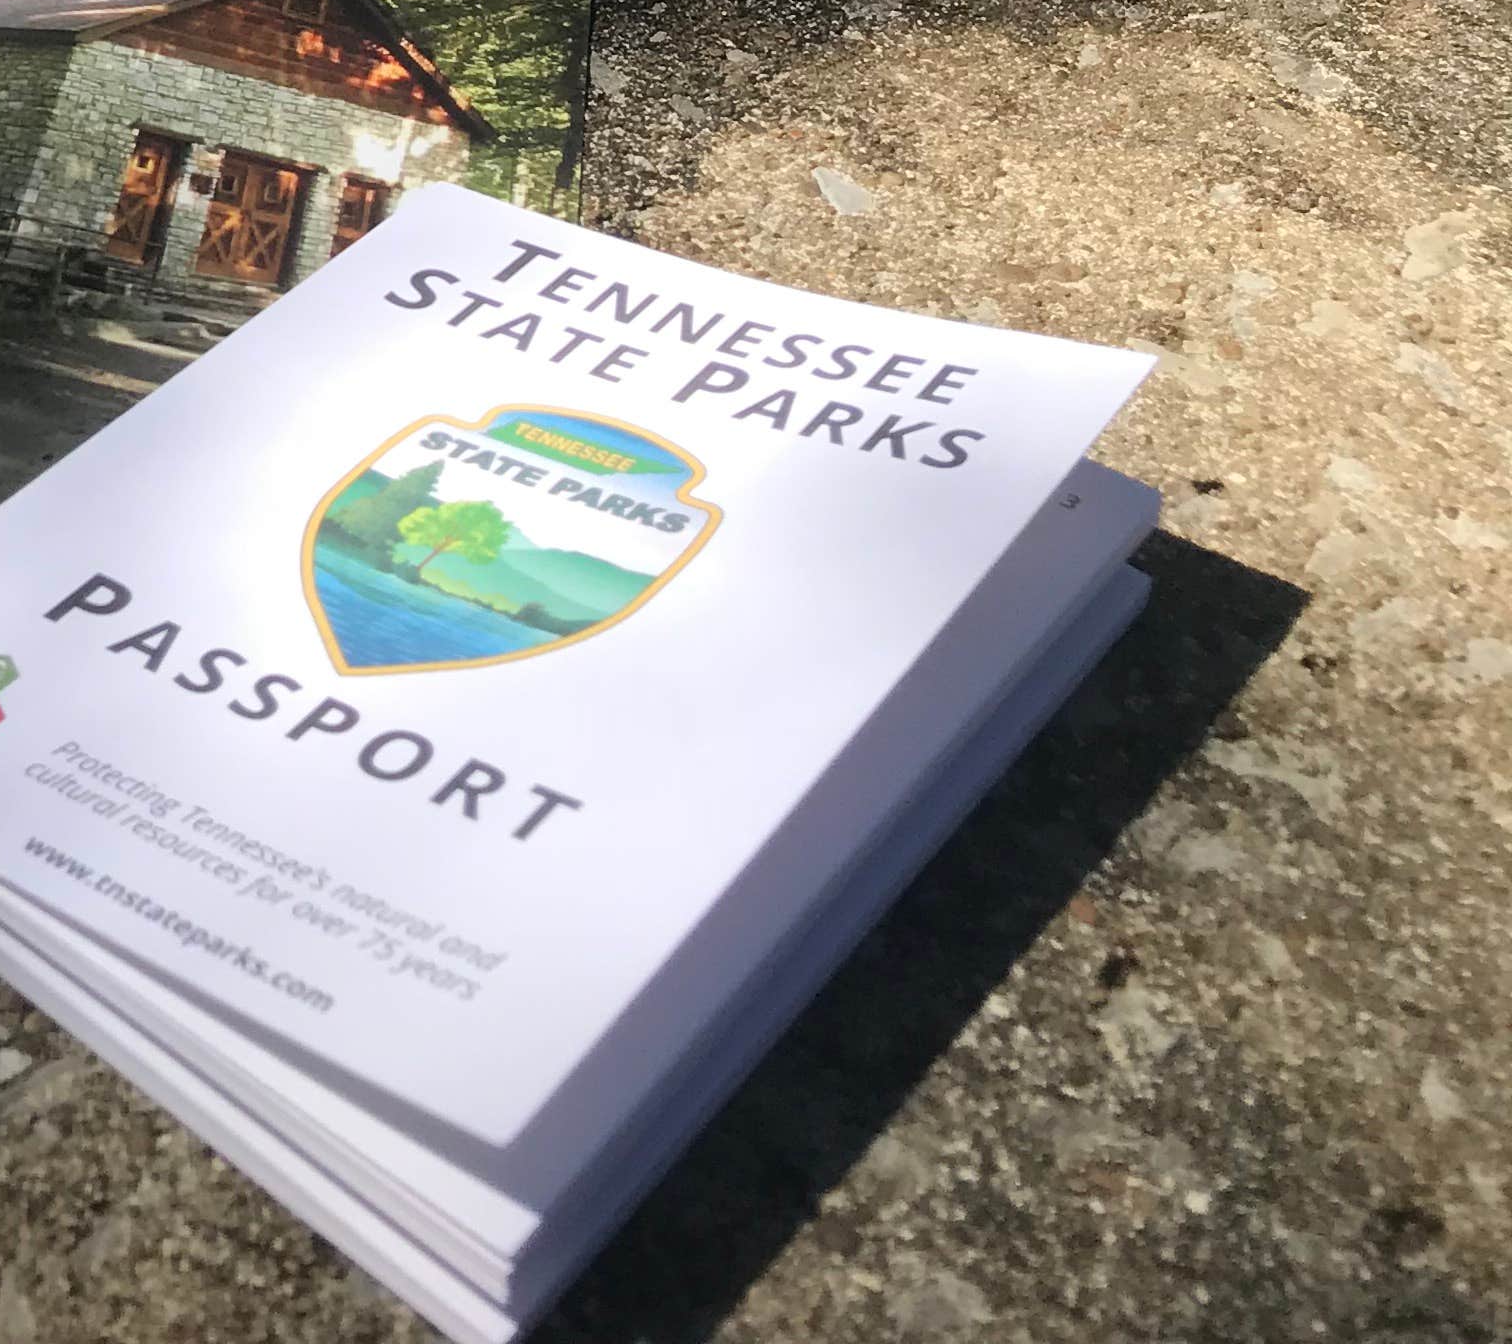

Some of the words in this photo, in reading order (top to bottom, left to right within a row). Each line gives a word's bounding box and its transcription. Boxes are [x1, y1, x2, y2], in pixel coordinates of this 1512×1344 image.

[383, 268, 651, 384] STATE
[670, 361, 987, 470] PARKS
[491, 239, 980, 406] TENNESSEE
[419, 430, 545, 489] STATE
[546, 476, 691, 535] PARKS
[514, 422, 638, 473] TENNESSEE
[43, 571, 584, 842] PASSPORT
[24, 759, 125, 819] cultural
[120, 808, 247, 886] resources
[232, 876, 295, 909] for
[291, 900, 358, 939] over
[357, 929, 404, 962] 75
[390, 945, 484, 1002] years
[24, 834, 335, 1013] www.tnstateparks.com
[52, 740, 183, 819] Protecting
[182, 804, 332, 893] Tennessee's
[329, 884, 445, 942] natural
[437, 934, 508, 972] and
